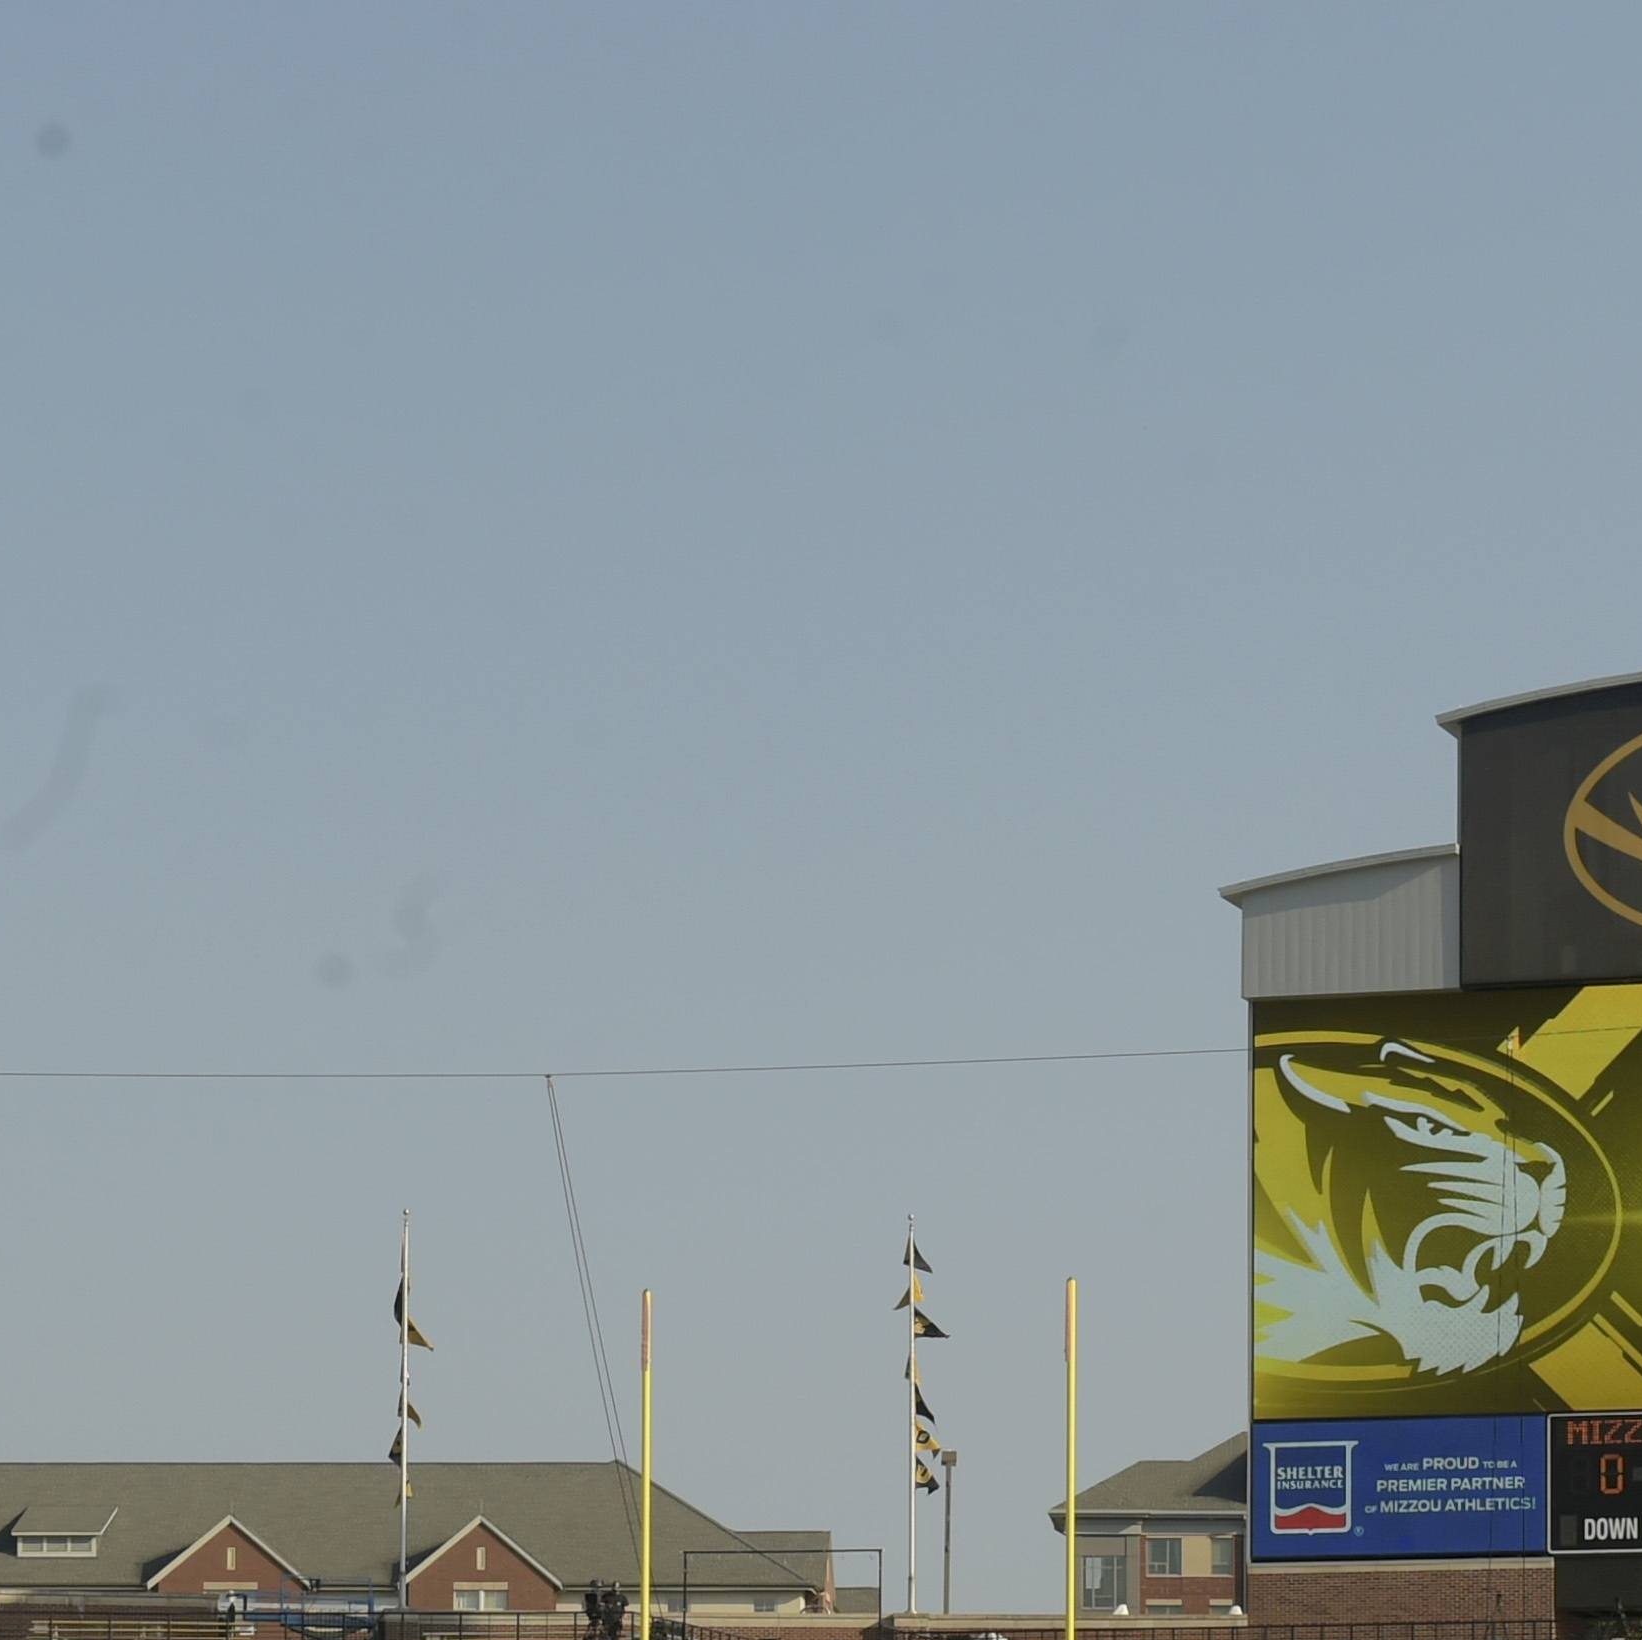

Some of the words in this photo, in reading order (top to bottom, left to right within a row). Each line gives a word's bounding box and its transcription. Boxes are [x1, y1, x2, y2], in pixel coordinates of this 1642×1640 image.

[1277, 1466, 1344, 1480] SHELTER
[1384, 1463, 1399, 1472] WE
[1400, 1462, 1419, 1471] ARE
[1422, 1457, 1479, 1471] PROUD
[1483, 1461, 1495, 1470] TO
[1496, 1460, 1509, 1469] BE
[1509, 1460, 1517, 1469] A
[1600, 1453, 1624, 1495] 0
[1277, 1479, 1344, 1490] INSURANCE
[1376, 1478, 1447, 1493] PREMIER
[1451, 1476, 1525, 1491] PARTNER
[1365, 1504, 1377, 1514] OF
[1380, 1499, 1442, 1514] MIZZOU
[1445, 1496, 1537, 1512] ATHLETICS!
[1584, 1517, 1638, 1540] DOWN
